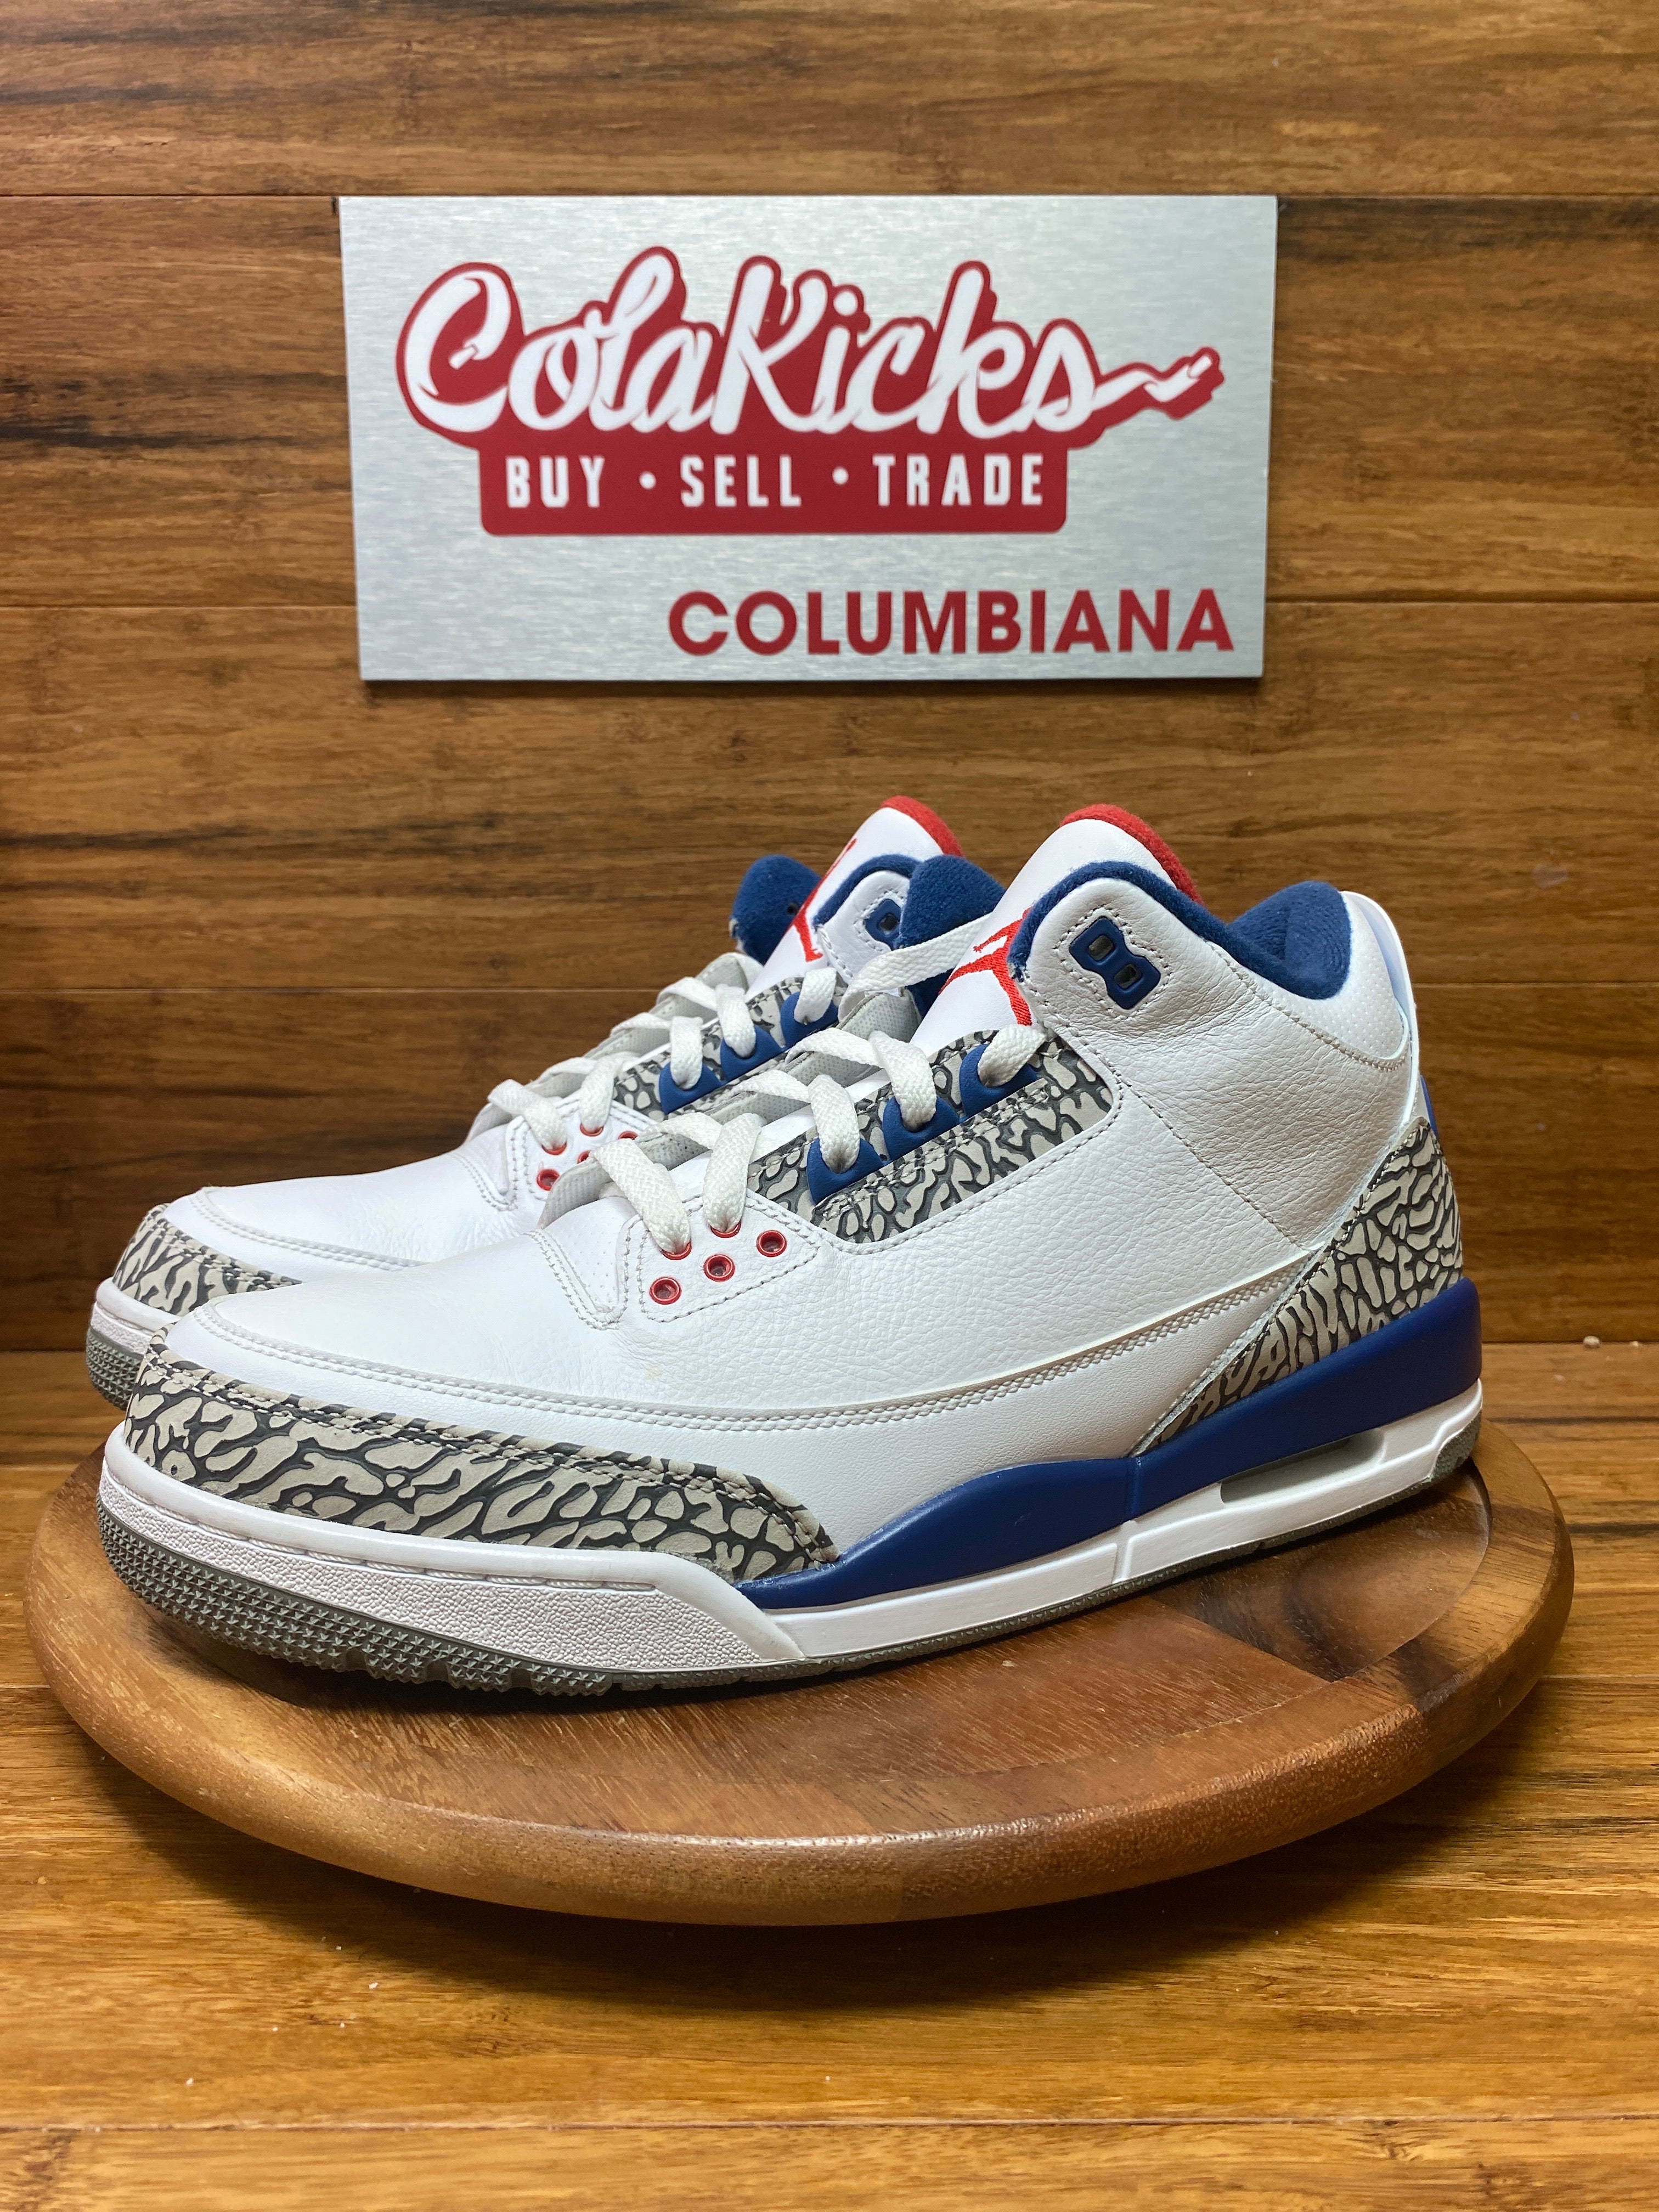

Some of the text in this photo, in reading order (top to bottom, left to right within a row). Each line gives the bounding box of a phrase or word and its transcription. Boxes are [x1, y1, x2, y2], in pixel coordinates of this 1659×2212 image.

[506, 454, 1043, 508] BUY SELL TRADE
[670, 590, 1233, 654] COLUMBIANA
